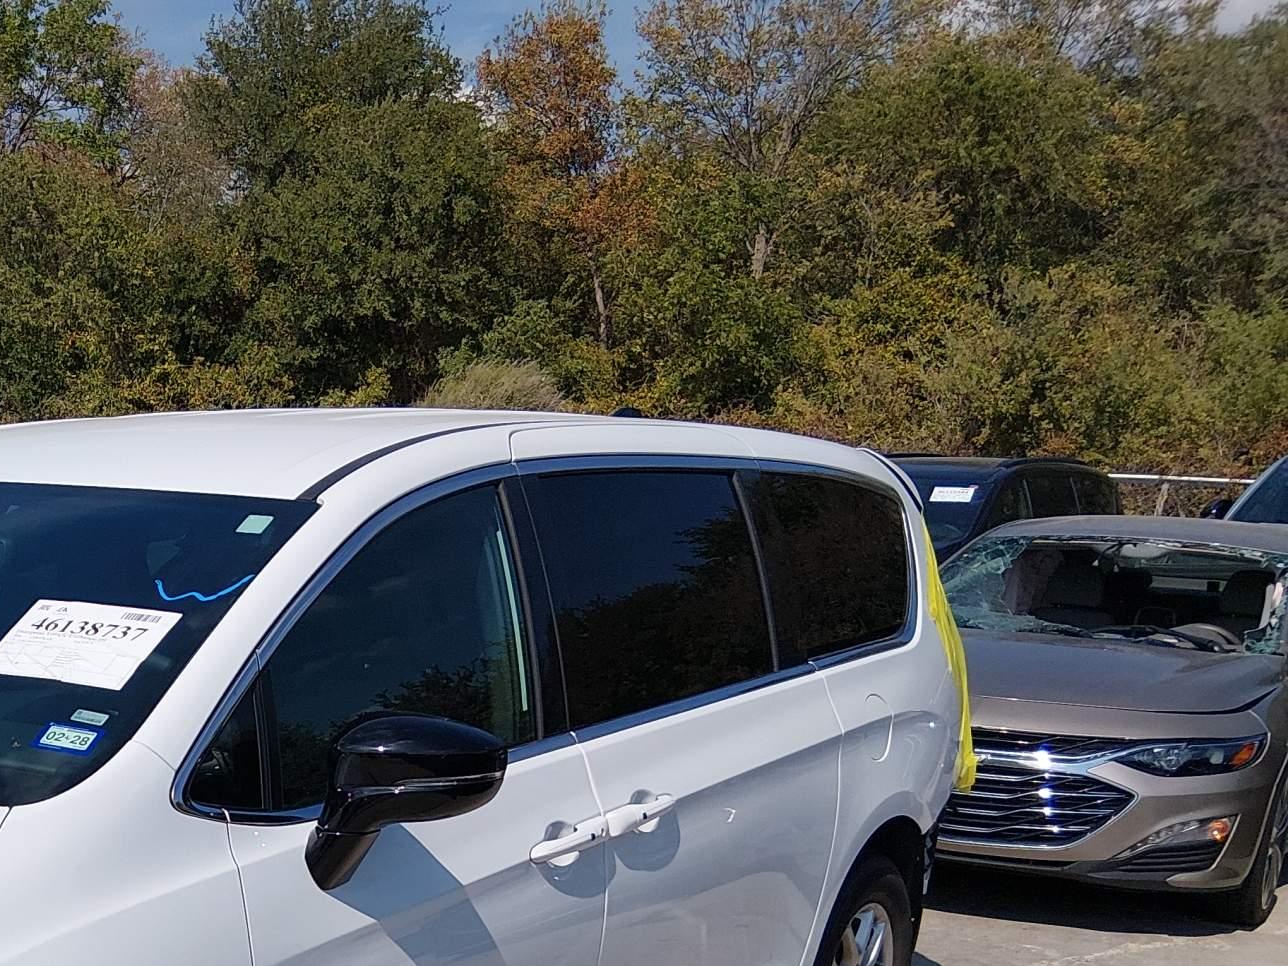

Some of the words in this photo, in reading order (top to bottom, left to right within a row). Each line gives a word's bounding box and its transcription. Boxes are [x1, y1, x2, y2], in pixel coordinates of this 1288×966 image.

[31, 617, 149, 641] 46138737
[45, 731, 66, 743] 02
[69, 735, 90, 746] 28
